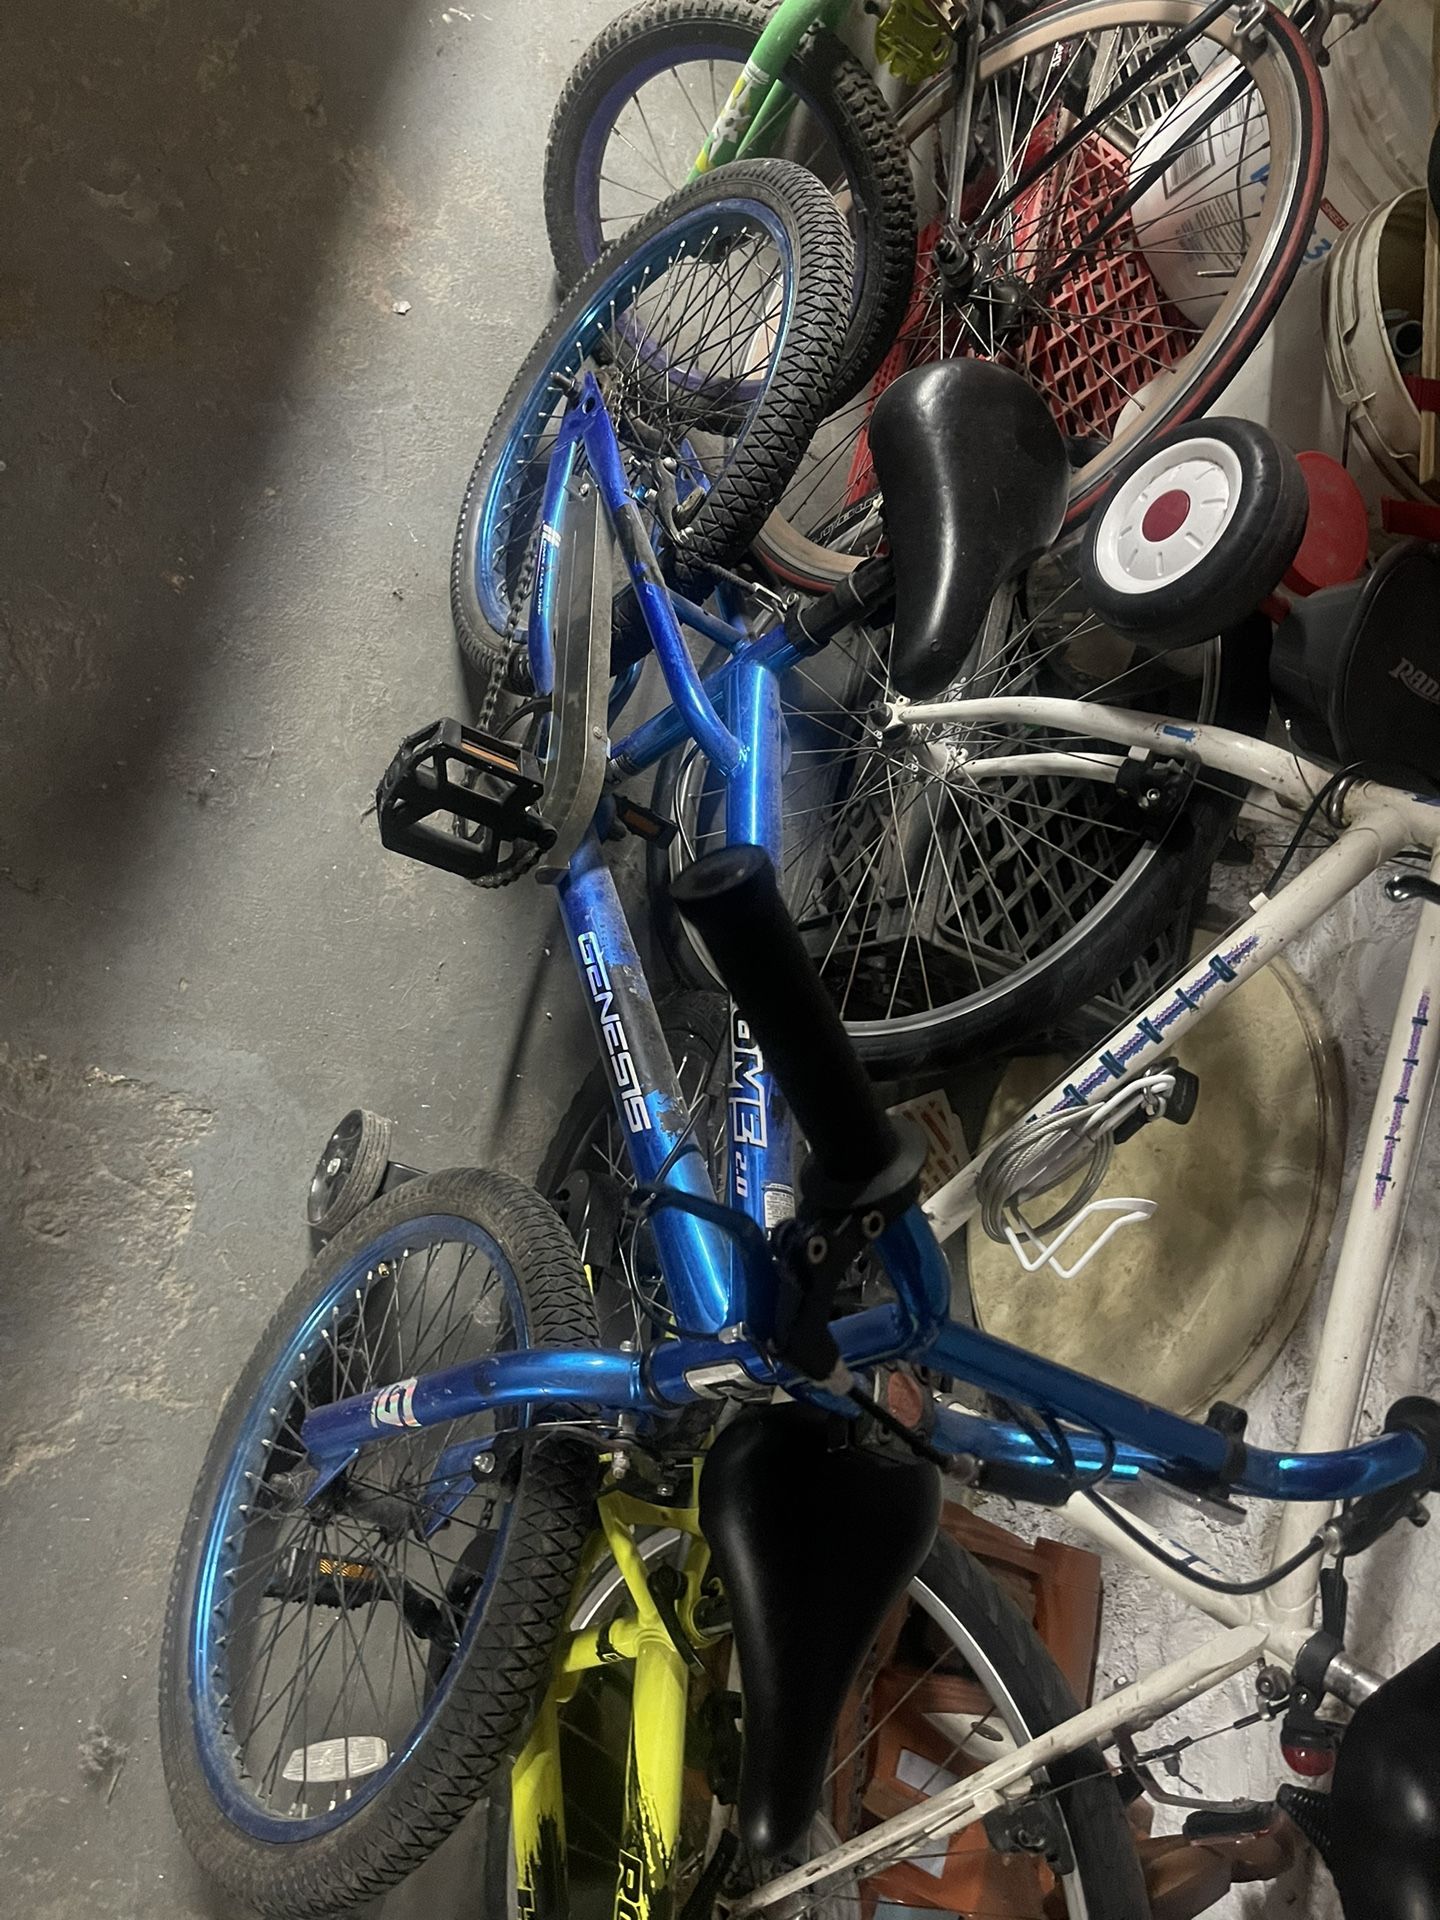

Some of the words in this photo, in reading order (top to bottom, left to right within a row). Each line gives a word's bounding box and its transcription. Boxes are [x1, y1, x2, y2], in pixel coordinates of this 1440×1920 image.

[1388, 657, 1440, 704] RAD
[578, 931, 652, 1133] GENESIS
[735, 1151, 749, 1198] 2.0
